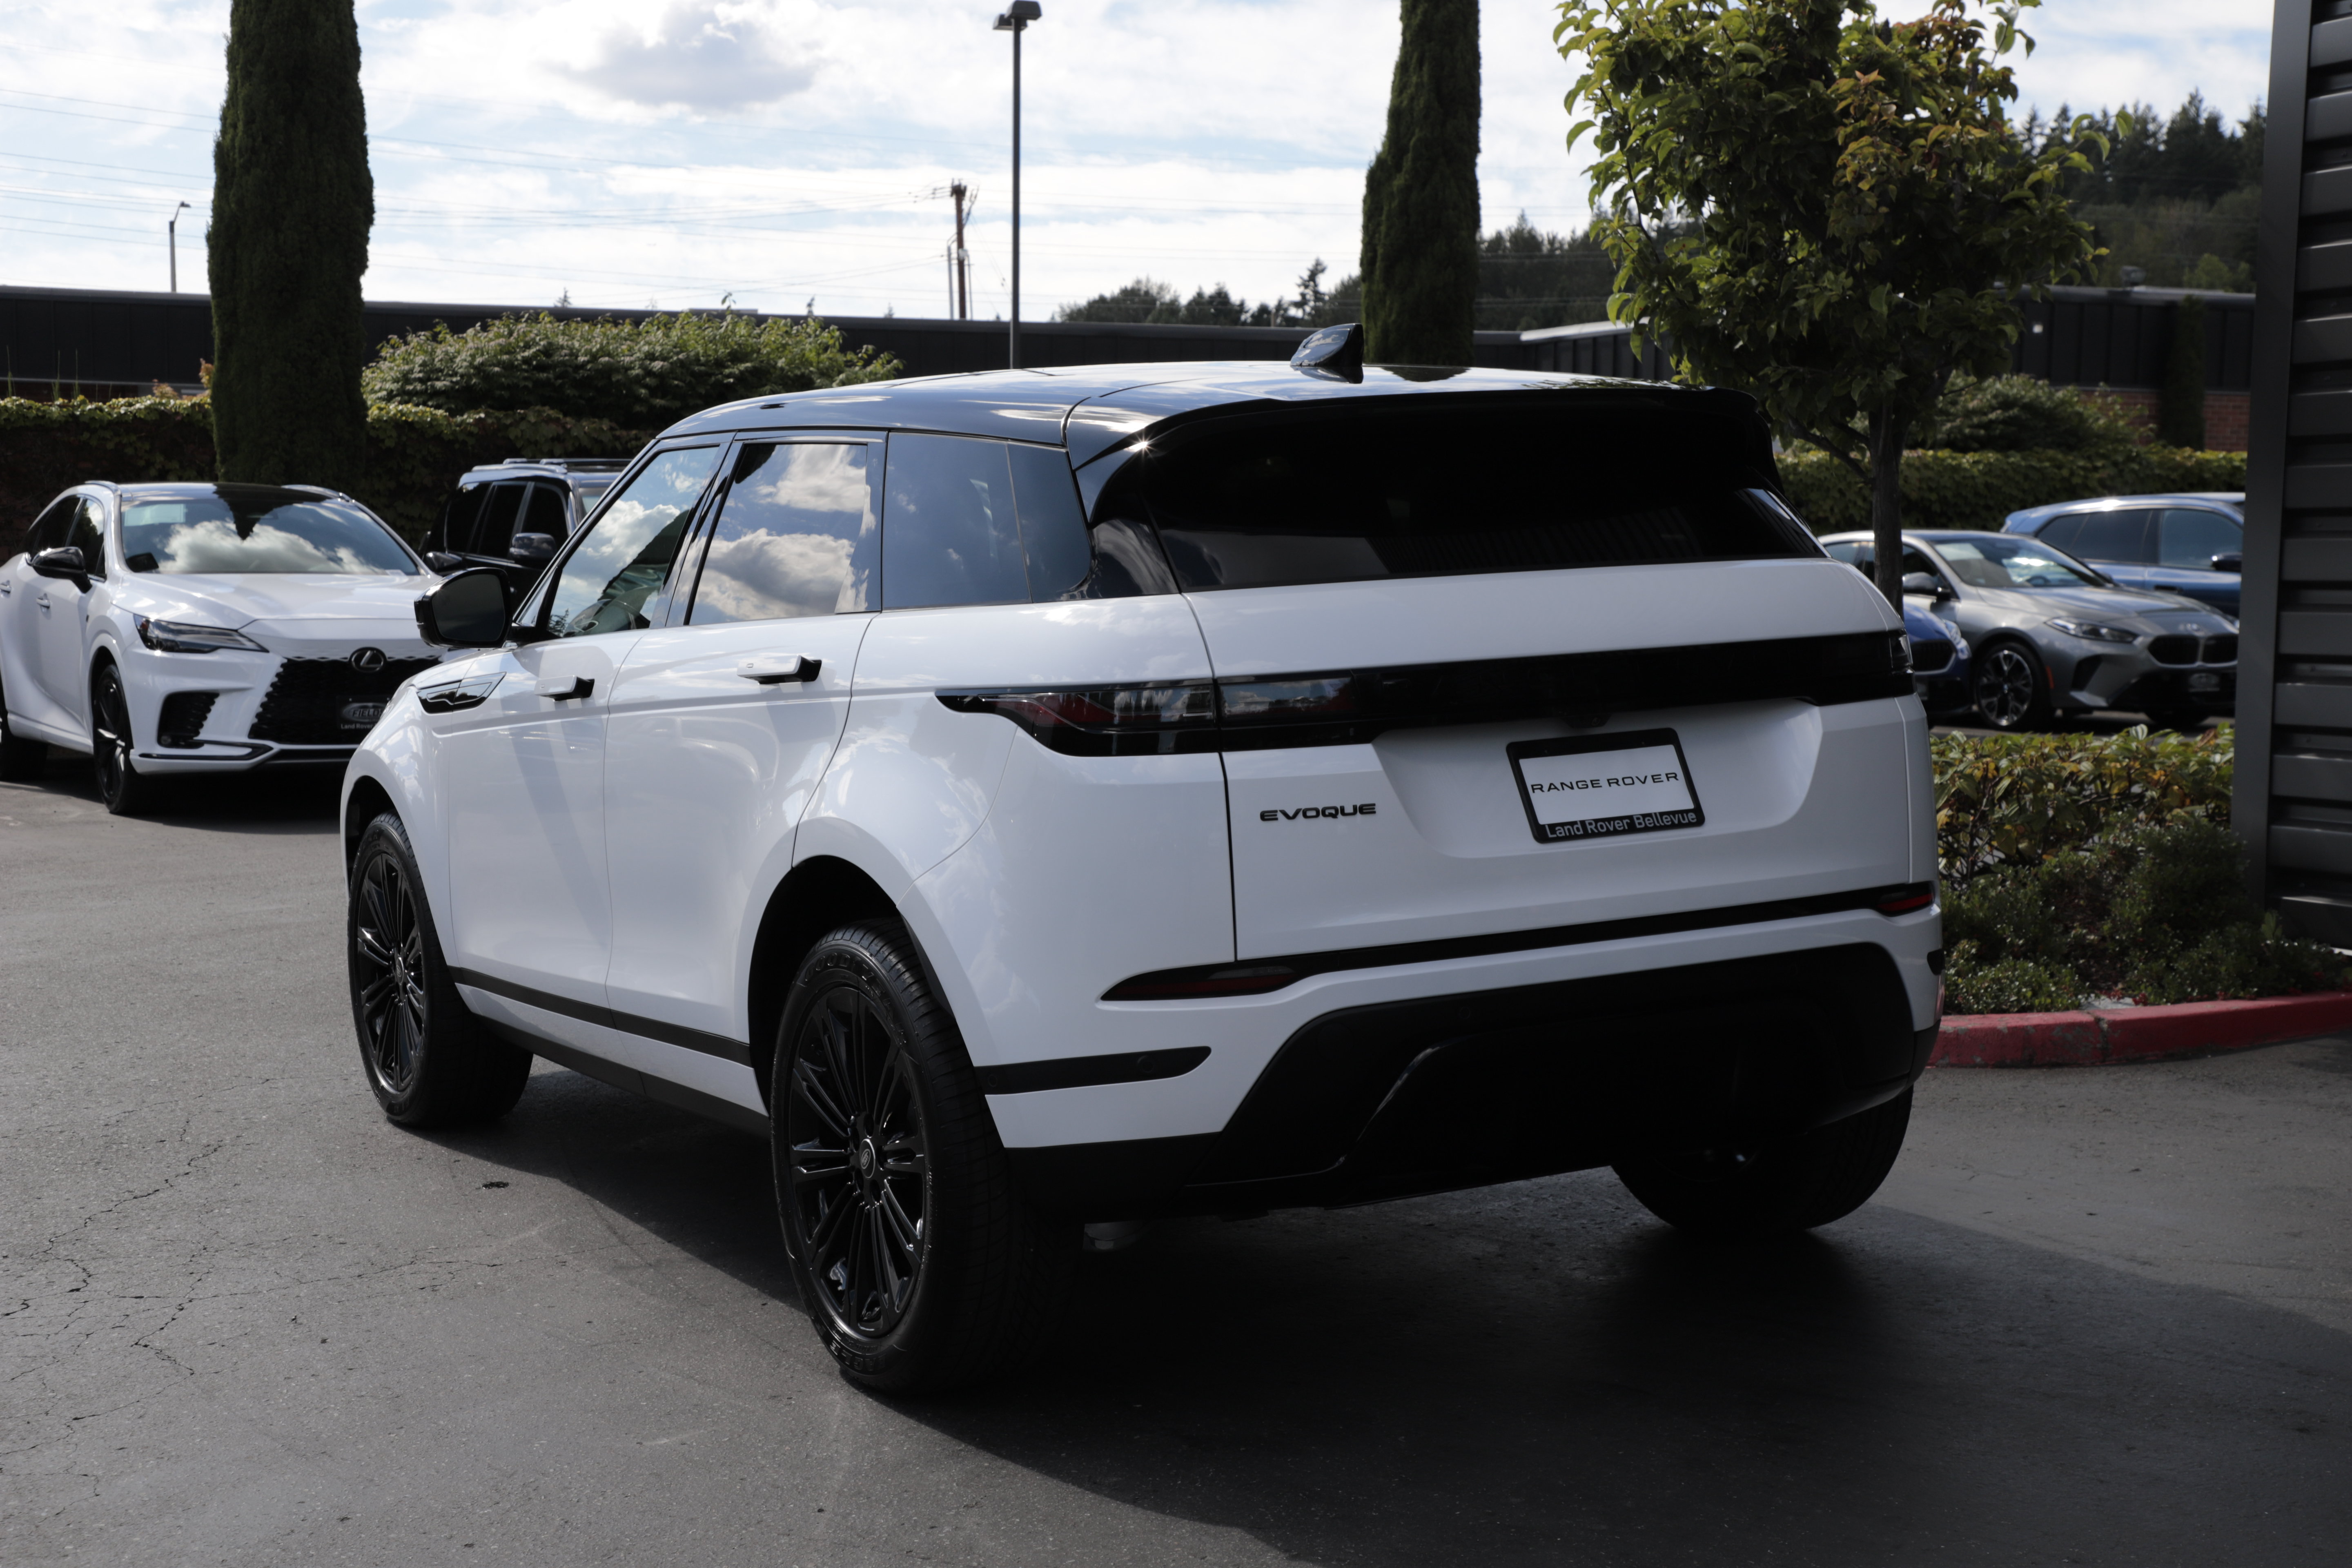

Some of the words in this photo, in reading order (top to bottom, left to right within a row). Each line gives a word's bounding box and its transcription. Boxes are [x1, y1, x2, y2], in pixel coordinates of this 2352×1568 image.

[1530, 779, 1603, 793] RANGE
[1607, 772, 1679, 787] ROVER
[1259, 803, 1376, 822] EVOQUE
[1545, 819, 1584, 838] Land
[1586, 818, 1630, 834] Rover
[1633, 812, 1697, 829] Bellevue
